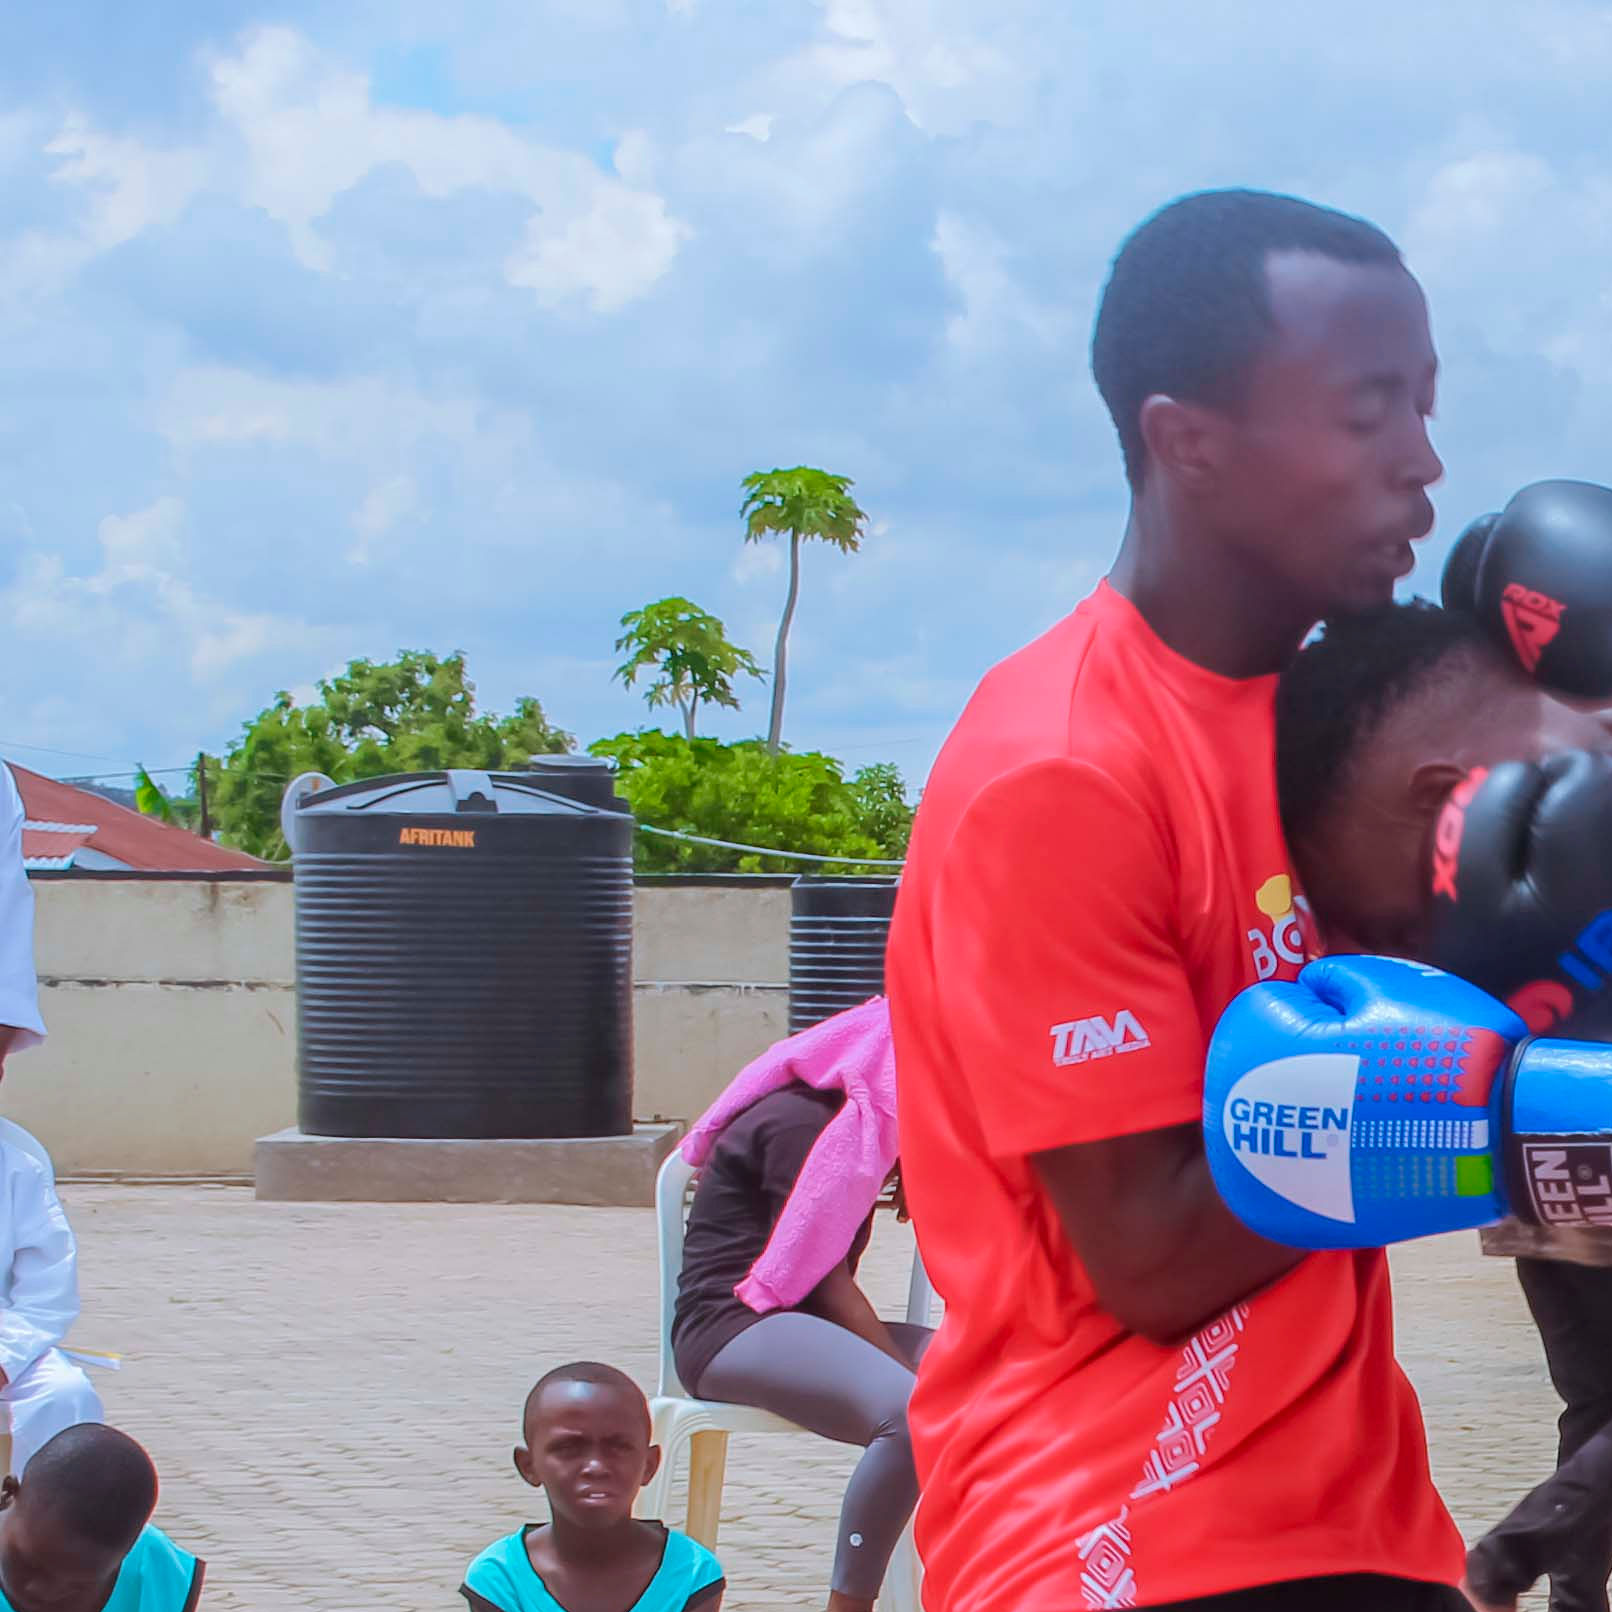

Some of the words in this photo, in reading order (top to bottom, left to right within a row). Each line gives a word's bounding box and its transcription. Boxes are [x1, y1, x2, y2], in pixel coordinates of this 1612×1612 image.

[399, 827, 476, 848] AFRITANK
[1230, 1098, 1348, 1130] GREEN
[1233, 1123, 1327, 1159] HILL
[1532, 1151, 1588, 1225] EEN
